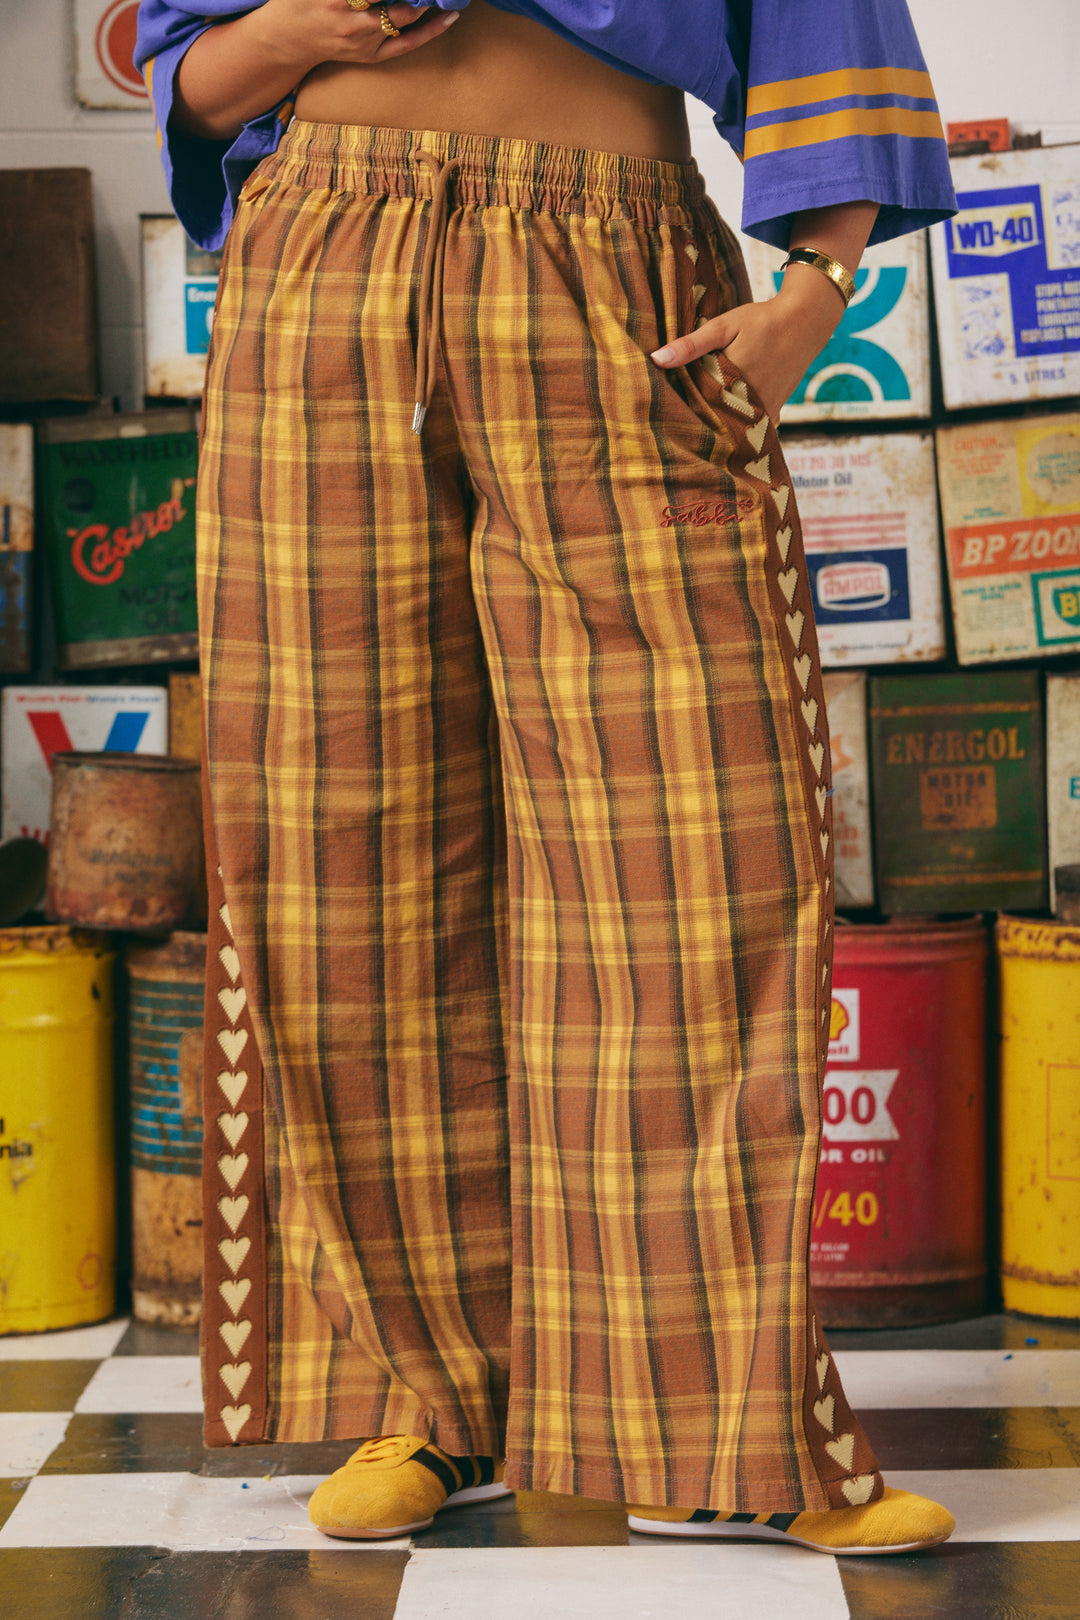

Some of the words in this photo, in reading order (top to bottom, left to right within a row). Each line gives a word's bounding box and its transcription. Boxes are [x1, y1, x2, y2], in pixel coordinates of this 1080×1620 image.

[956, 216, 1033, 249] WD-40
[1024, 368, 1066, 384] LITRES
[72, 478, 189, 585] Castrol
[959, 534, 1007, 568] BP
[823, 575, 885, 598] AMPOL
[886, 727, 1026, 765] ENERGOL
[823, 1087, 876, 1125] 00
[850, 1148, 885, 1163] OIL
[813, 1189, 880, 1228] /40
